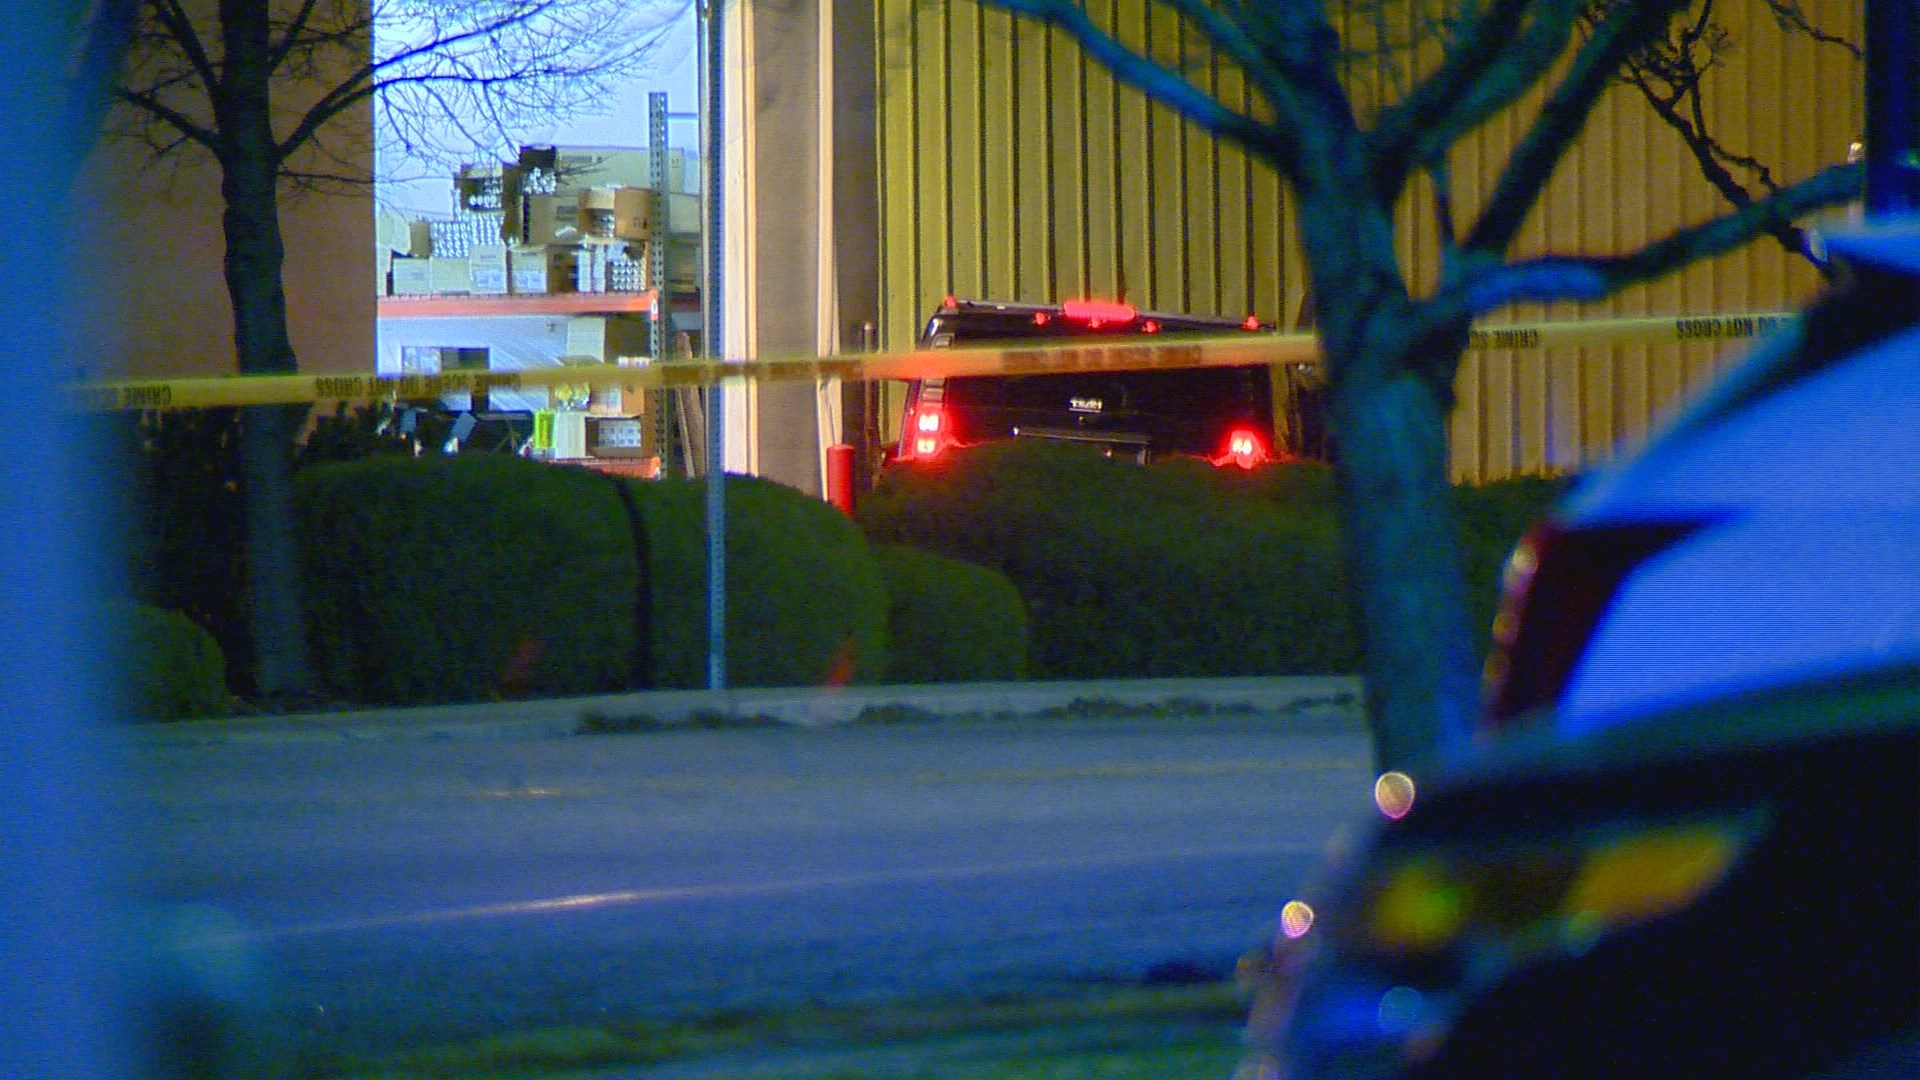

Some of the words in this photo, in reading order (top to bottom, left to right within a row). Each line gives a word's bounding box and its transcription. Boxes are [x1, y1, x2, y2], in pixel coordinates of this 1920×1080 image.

[1493, 328, 1539, 348] CRIME
[1676, 318, 1721, 340] CROSS
[1726, 317, 1754, 338] NOT
[123, 385, 172, 407] CRIME
[315, 377, 363, 399] CROSS
